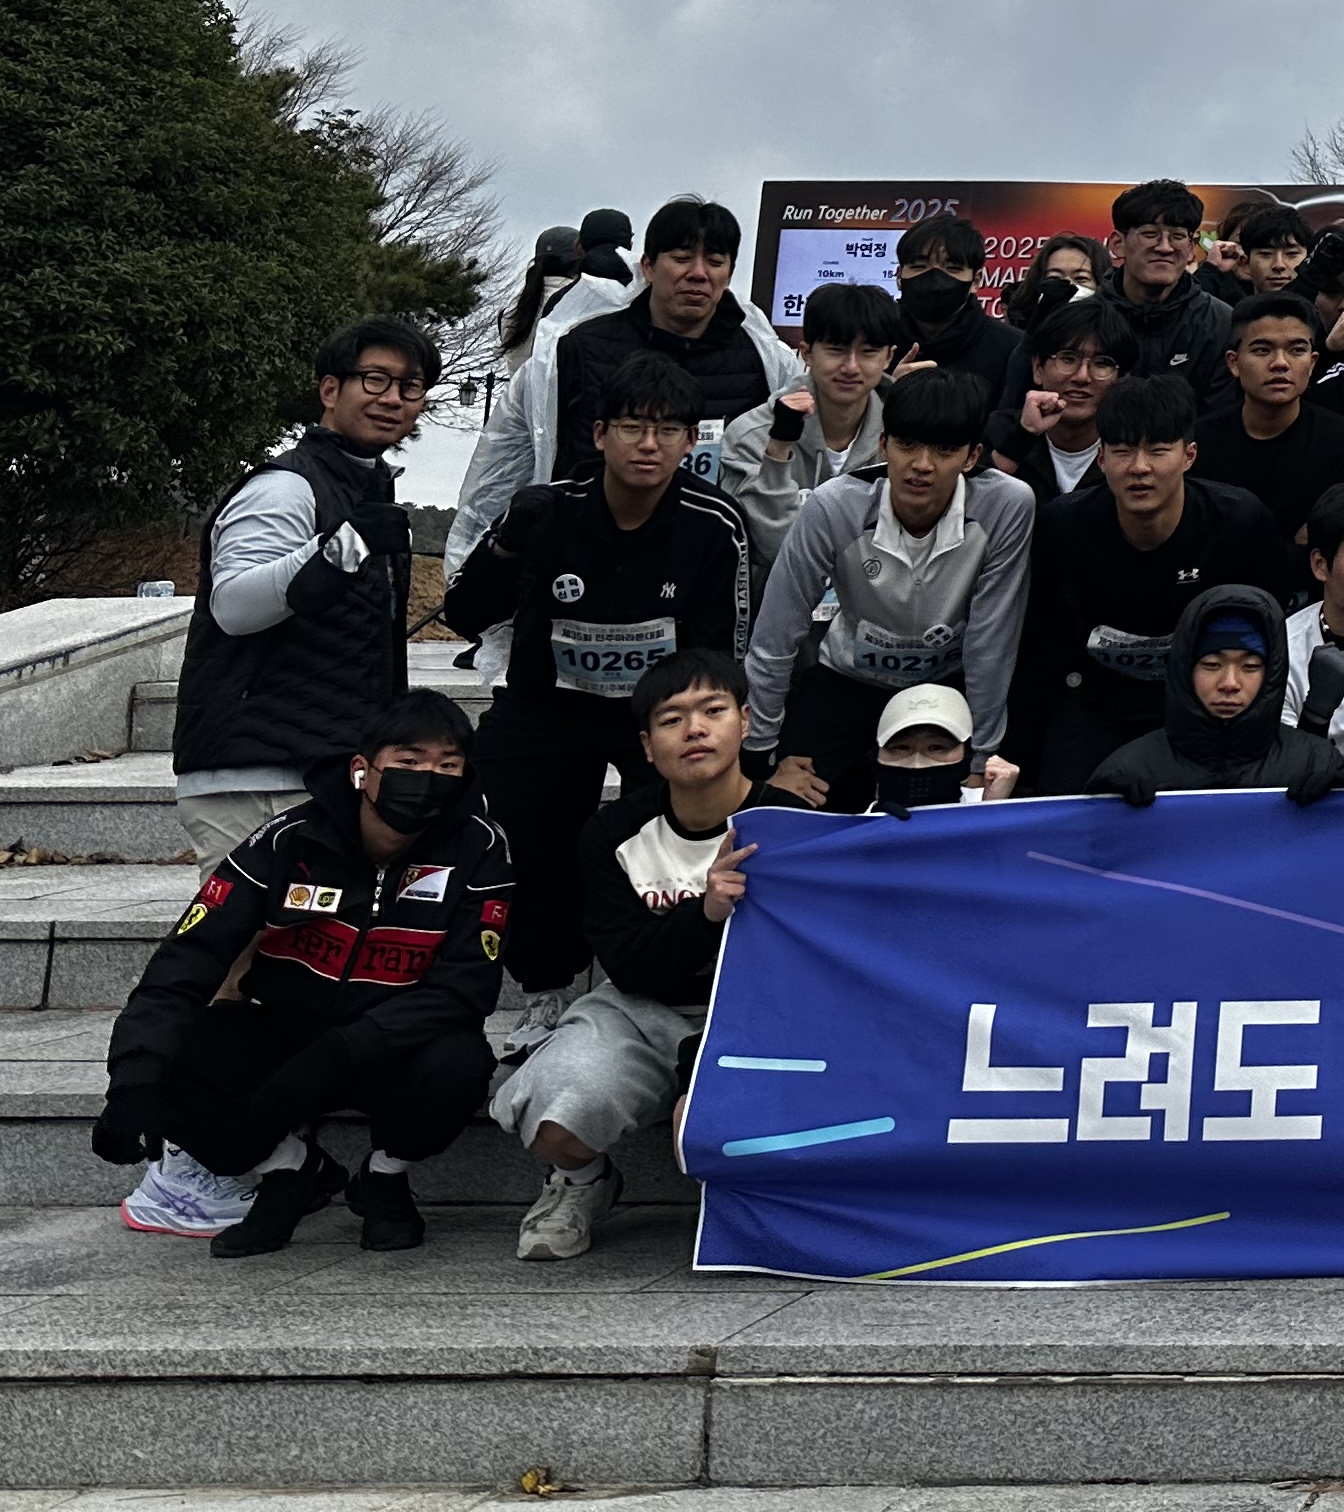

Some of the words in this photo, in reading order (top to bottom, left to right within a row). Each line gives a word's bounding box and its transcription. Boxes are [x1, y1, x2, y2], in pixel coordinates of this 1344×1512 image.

[782, 205, 813, 221] Run
[817, 205, 888, 222] Together
[889, 198, 961, 224] 2025
[845, 242, 888, 258] 박연정
[817, 270, 845, 278] 10km
[562, 647, 666, 672] 10265
[947, 1000, 1323, 1144] 느려도
